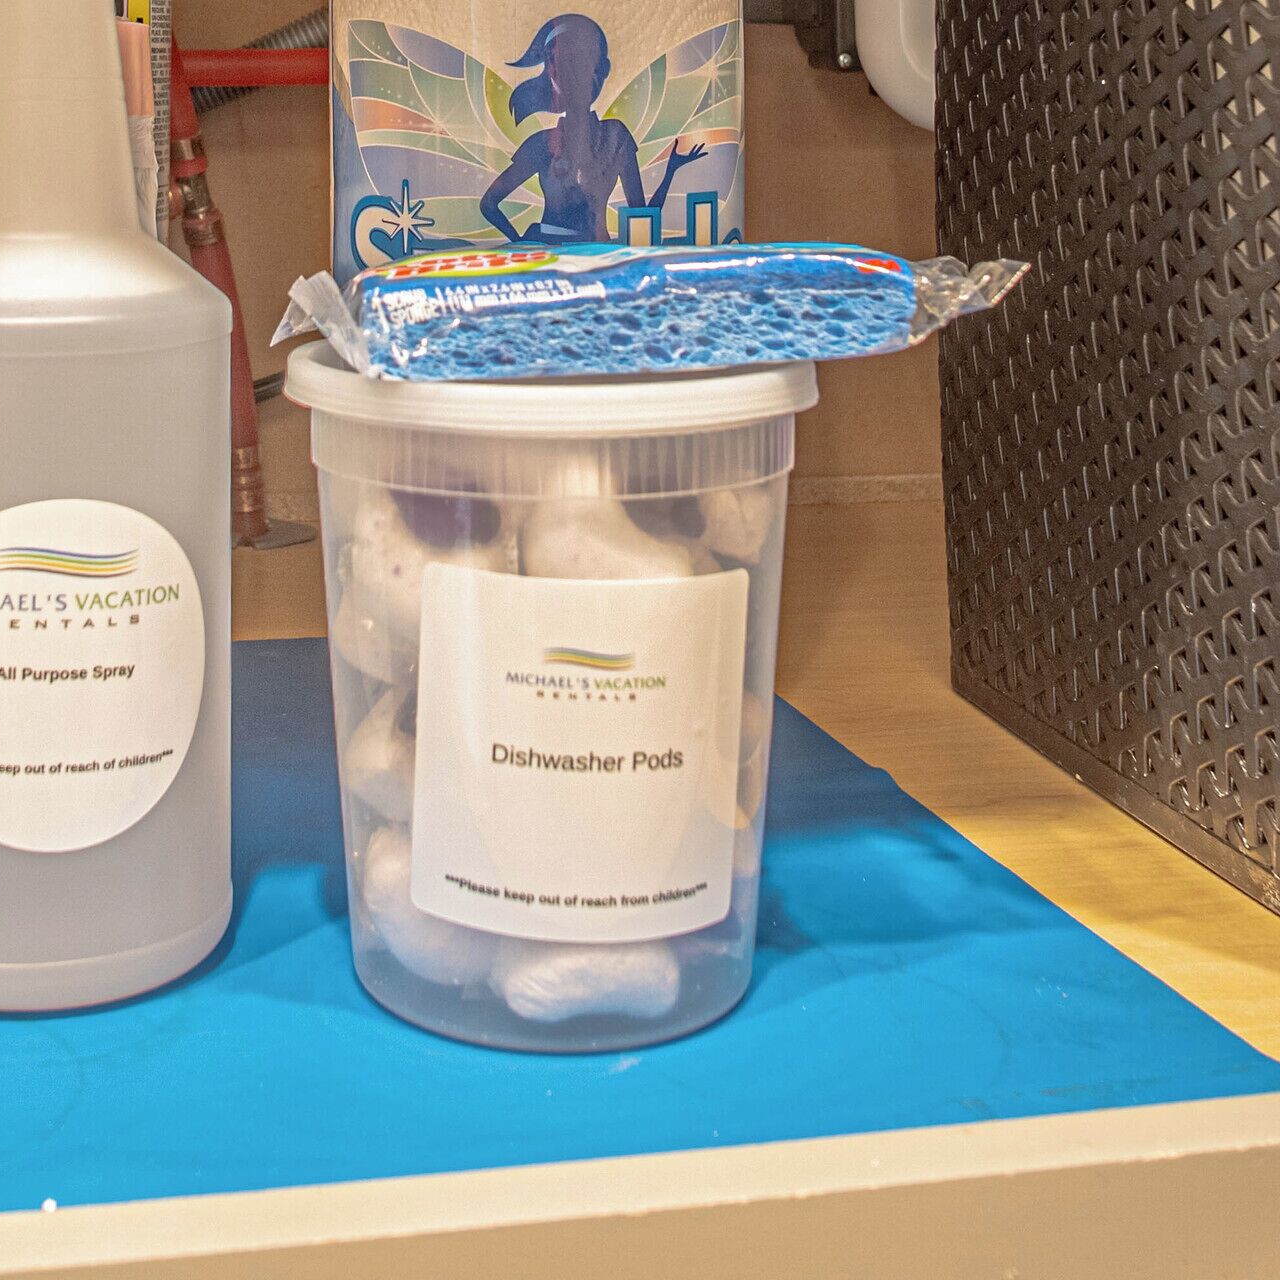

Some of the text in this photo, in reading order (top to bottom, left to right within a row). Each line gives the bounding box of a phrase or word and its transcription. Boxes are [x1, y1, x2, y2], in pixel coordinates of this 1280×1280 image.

[75, 583, 180, 611] VACATION
[22, 667, 88, 684] Purpose
[92, 664, 136, 681] Spray
[505, 671, 667, 691] MICHAEL'S VACATION
[24, 763, 45, 775] out
[49, 762, 62, 774] of
[65, 760, 100, 774] reach
[103, 757, 117, 770] of
[491, 743, 685, 772] Dishwasher Pods
[503, 886, 536, 907] keep
[538, 894, 561, 906] out
[563, 893, 579, 907] of
[581, 894, 618, 908] reach
[620, 893, 650, 907] from
